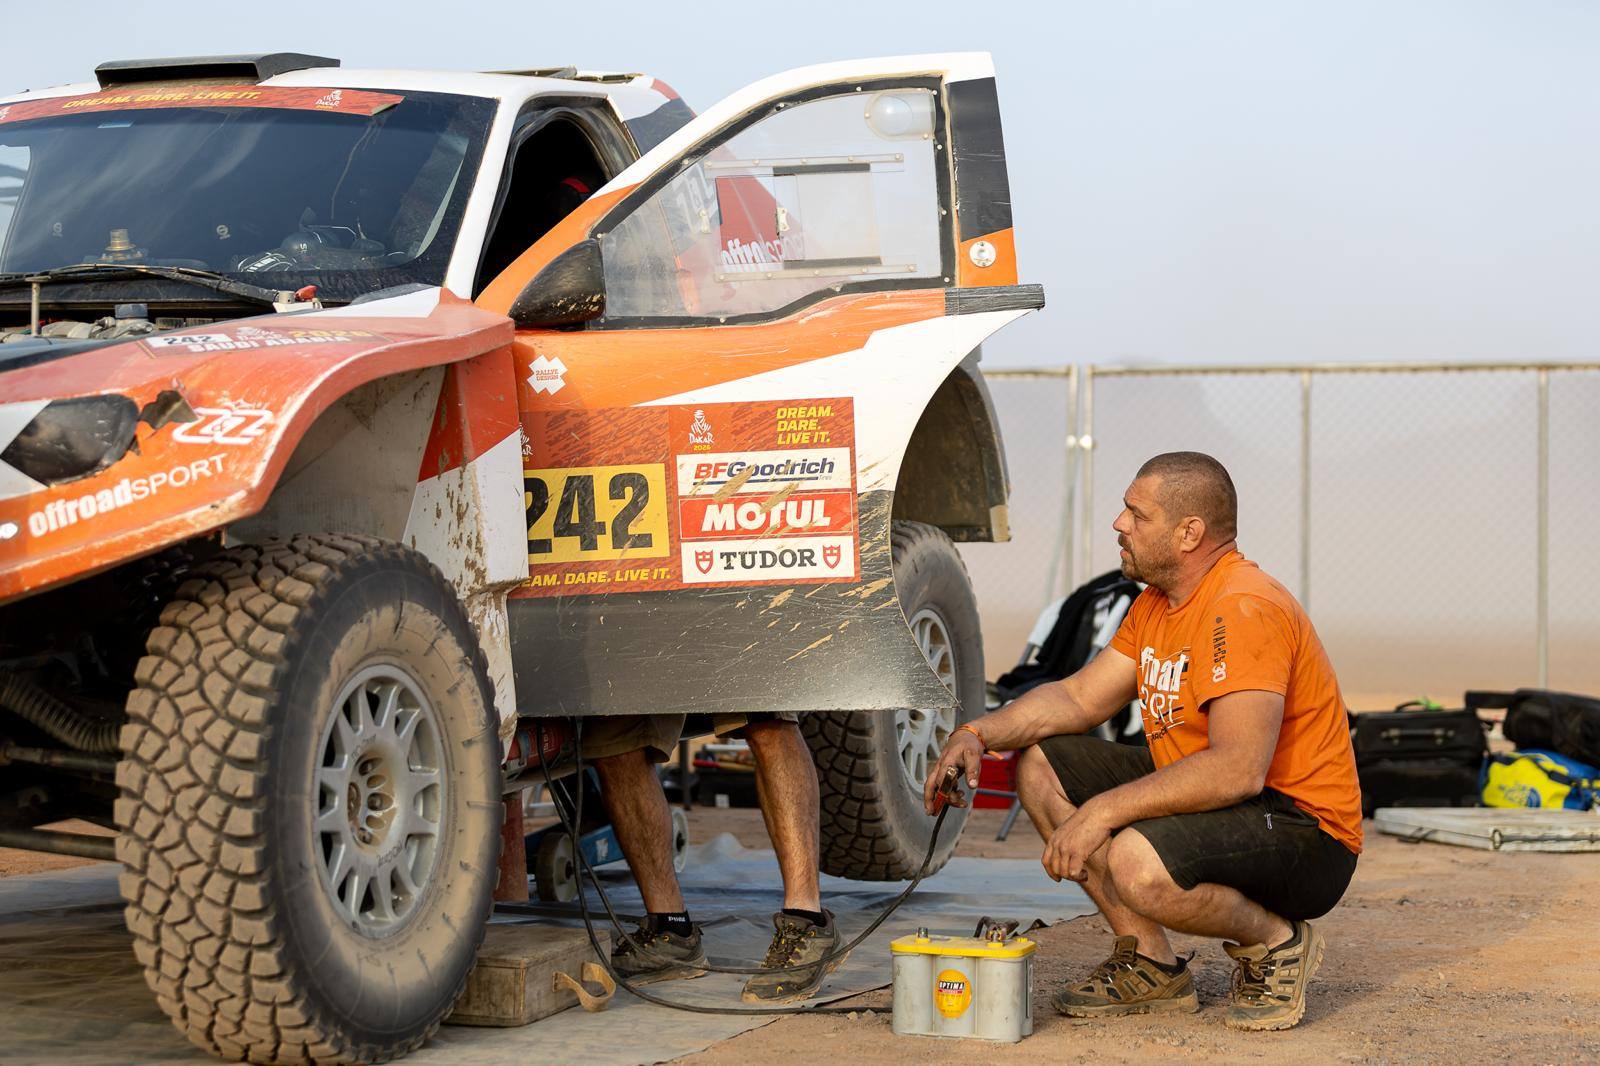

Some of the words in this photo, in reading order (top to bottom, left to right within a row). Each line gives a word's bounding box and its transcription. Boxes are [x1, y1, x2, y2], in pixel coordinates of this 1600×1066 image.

[62, 95, 132, 109] DREAM.
[133, 92, 189, 102] DARE.
[192, 91, 238, 100] LIVE
[187, 340, 260, 352] SAUDI
[264, 335, 351, 347] ARABIA
[776, 406, 835, 419] DREAM.
[777, 419, 821, 432] DARE.
[689, 433, 715, 445] DAKAR
[777, 432, 811, 445] LIVE
[812, 431, 831, 443] IT.
[694, 458, 835, 480] BFGoodrich
[524, 472, 653, 555] 242
[701, 499, 831, 532] MOTUL
[720, 549, 817, 571] TUDOR
[520, 575, 560, 588] EAM.
[564, 571, 611, 584] DARE.
[614, 569, 650, 582] LIVE
[652, 568, 671, 580] IT.
